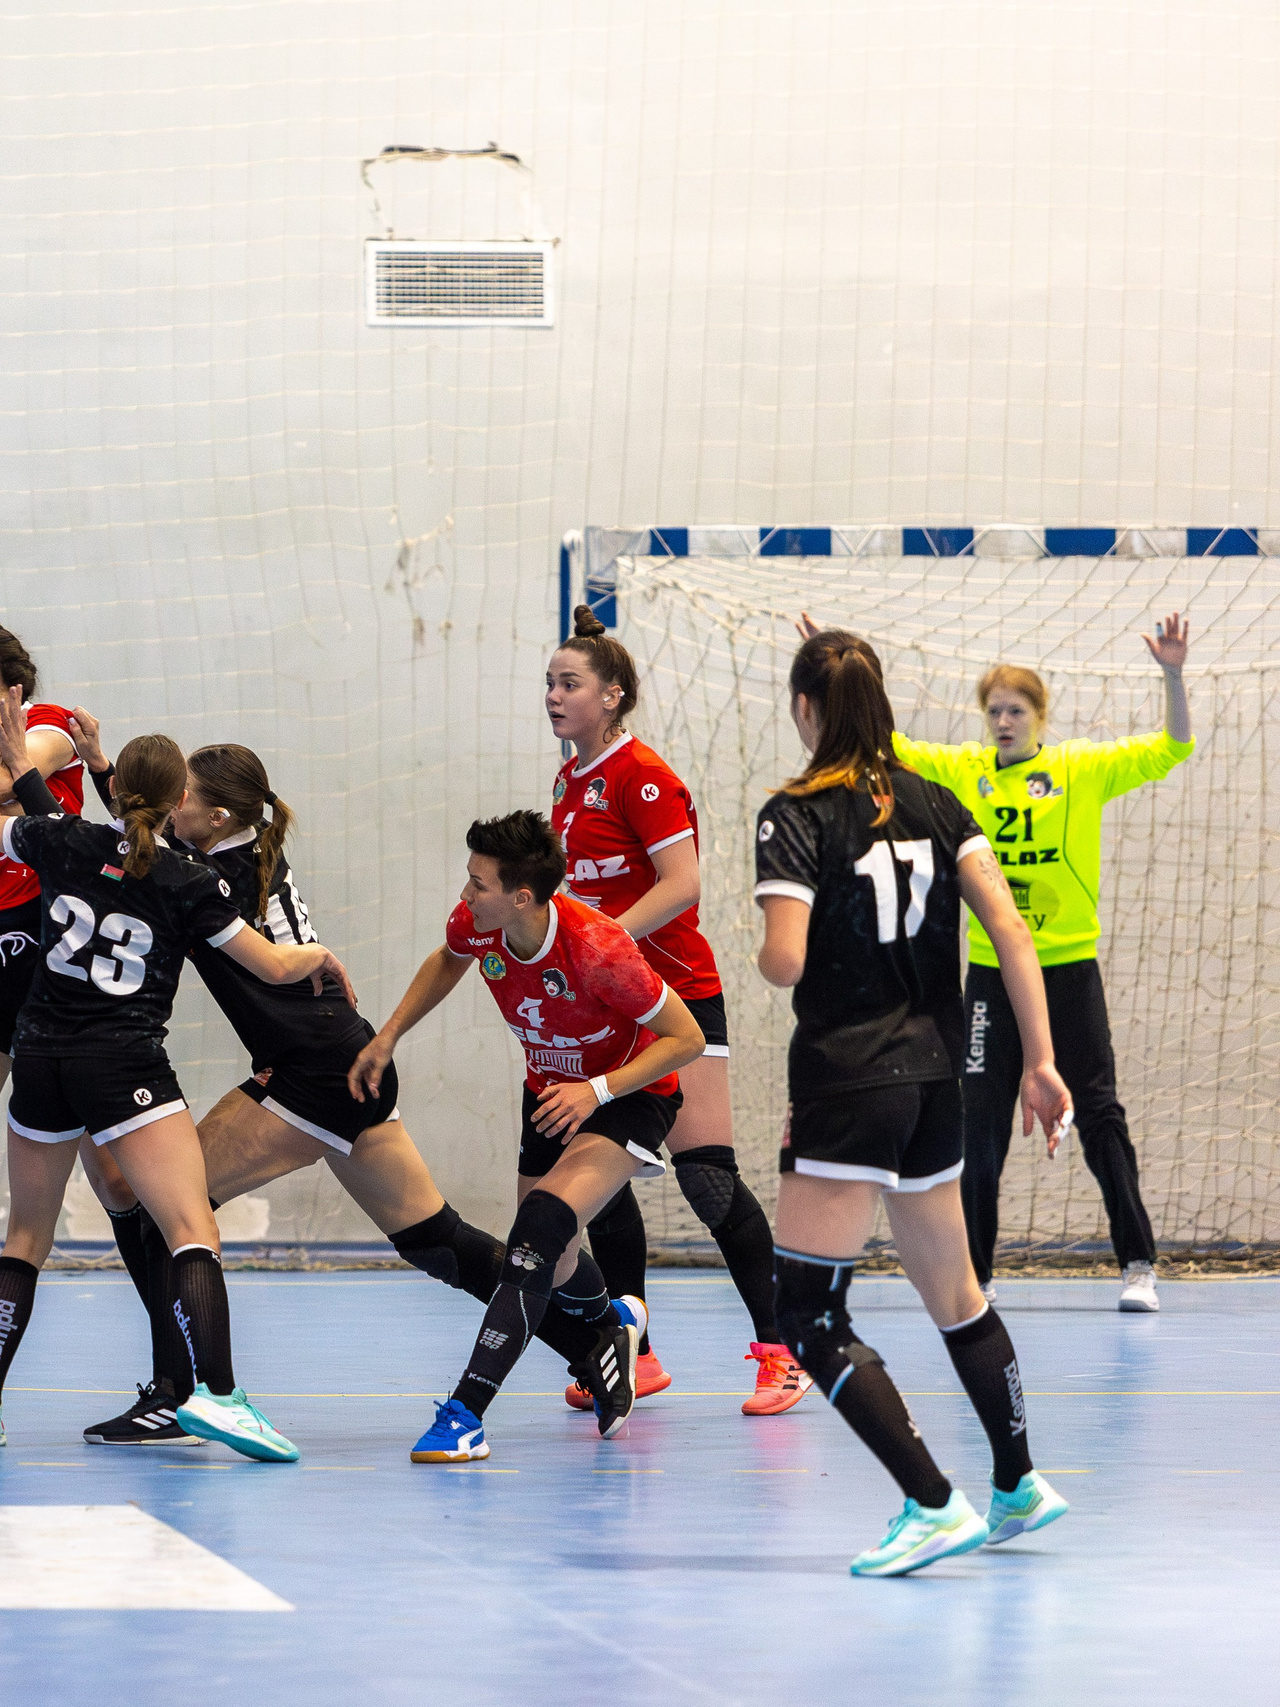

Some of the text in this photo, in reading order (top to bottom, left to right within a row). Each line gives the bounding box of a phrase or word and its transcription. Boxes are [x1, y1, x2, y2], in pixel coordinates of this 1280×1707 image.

[995, 806, 1034, 844] 21
[854, 838, 935, 944] 17
[46, 894, 154, 996] 23
[966, 1000, 991, 1074] Kempa
